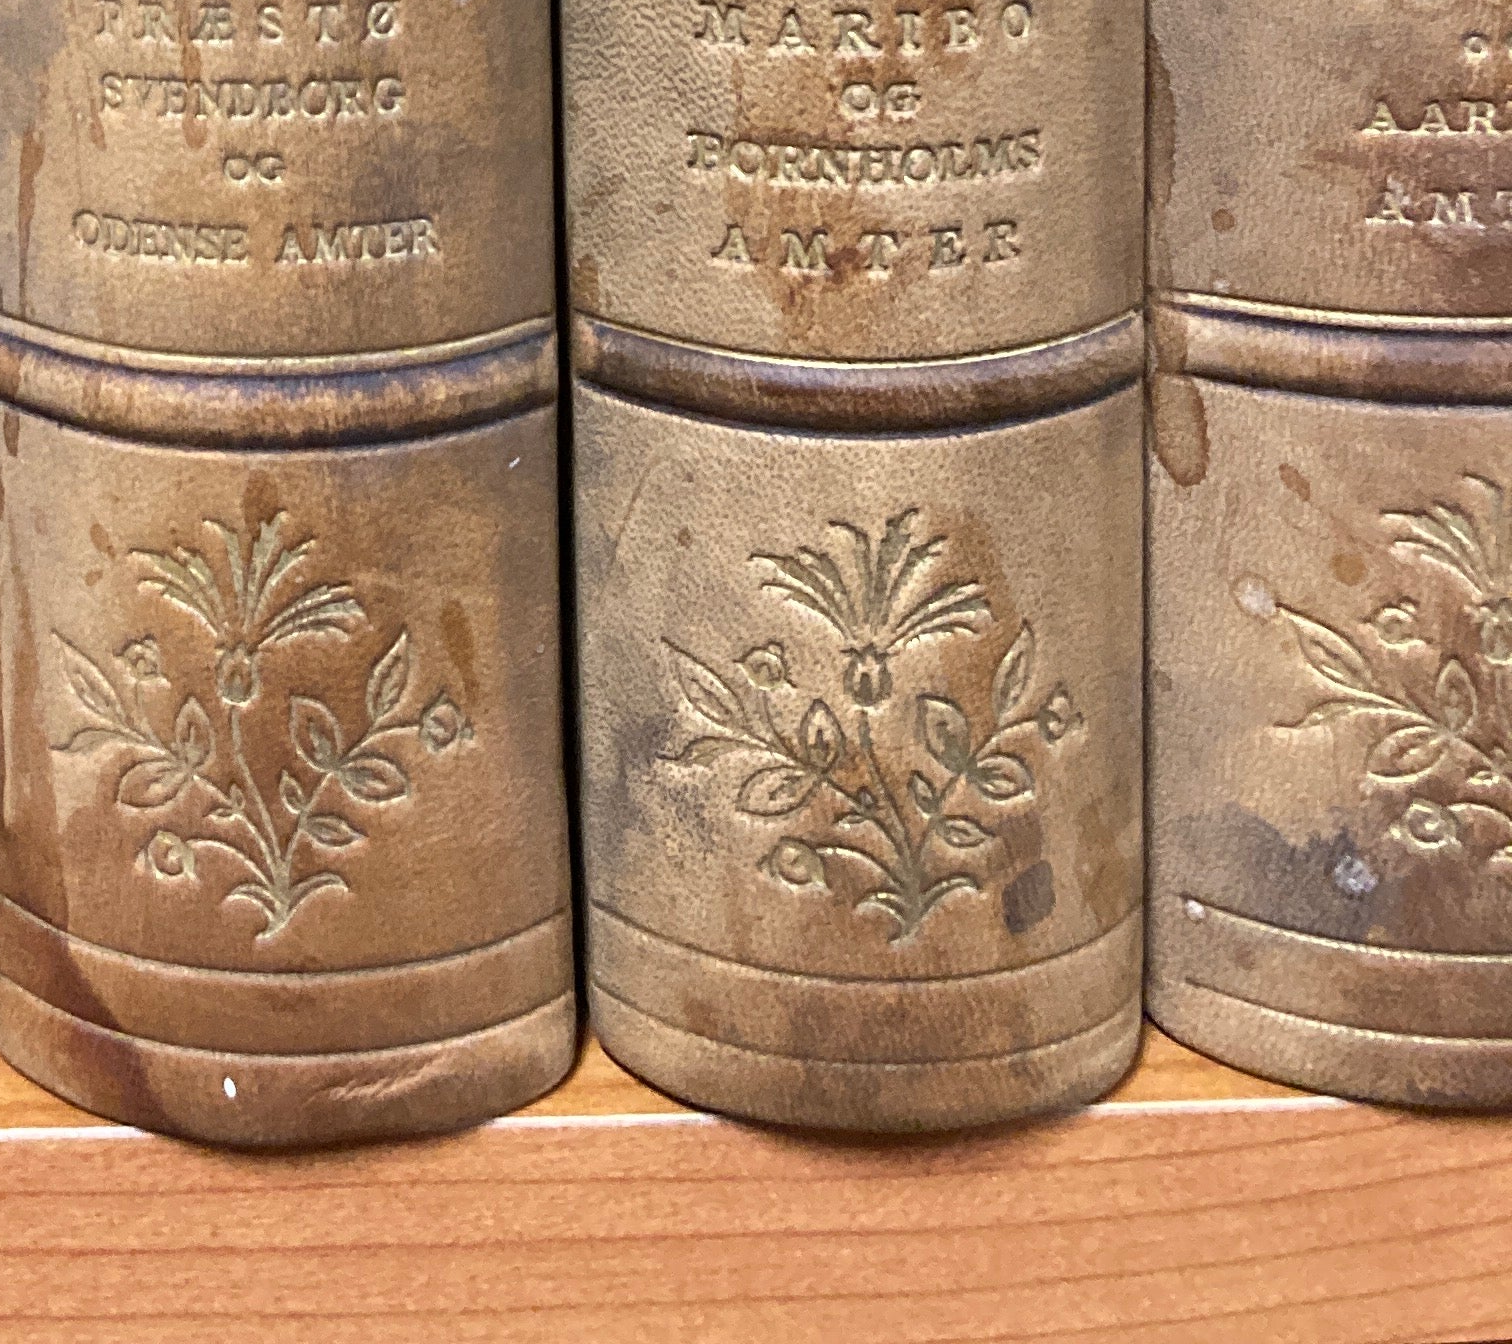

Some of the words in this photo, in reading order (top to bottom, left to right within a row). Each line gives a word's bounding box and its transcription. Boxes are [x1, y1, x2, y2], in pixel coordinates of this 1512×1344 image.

[96, 0, 402, 46] PRÆSTØ
[1462, 33, 1512, 63] O
[100, 73, 405, 119] SVENDBORG
[840, 80, 922, 119] OG
[1361, 100, 1512, 136] AAR
[223, 152, 285, 185] OG
[686, 130, 1042, 186] BORNHOLMS
[72, 210, 248, 265] ODENSE
[275, 216, 438, 265] AMTER
[710, 222, 1020, 275] AMTER
